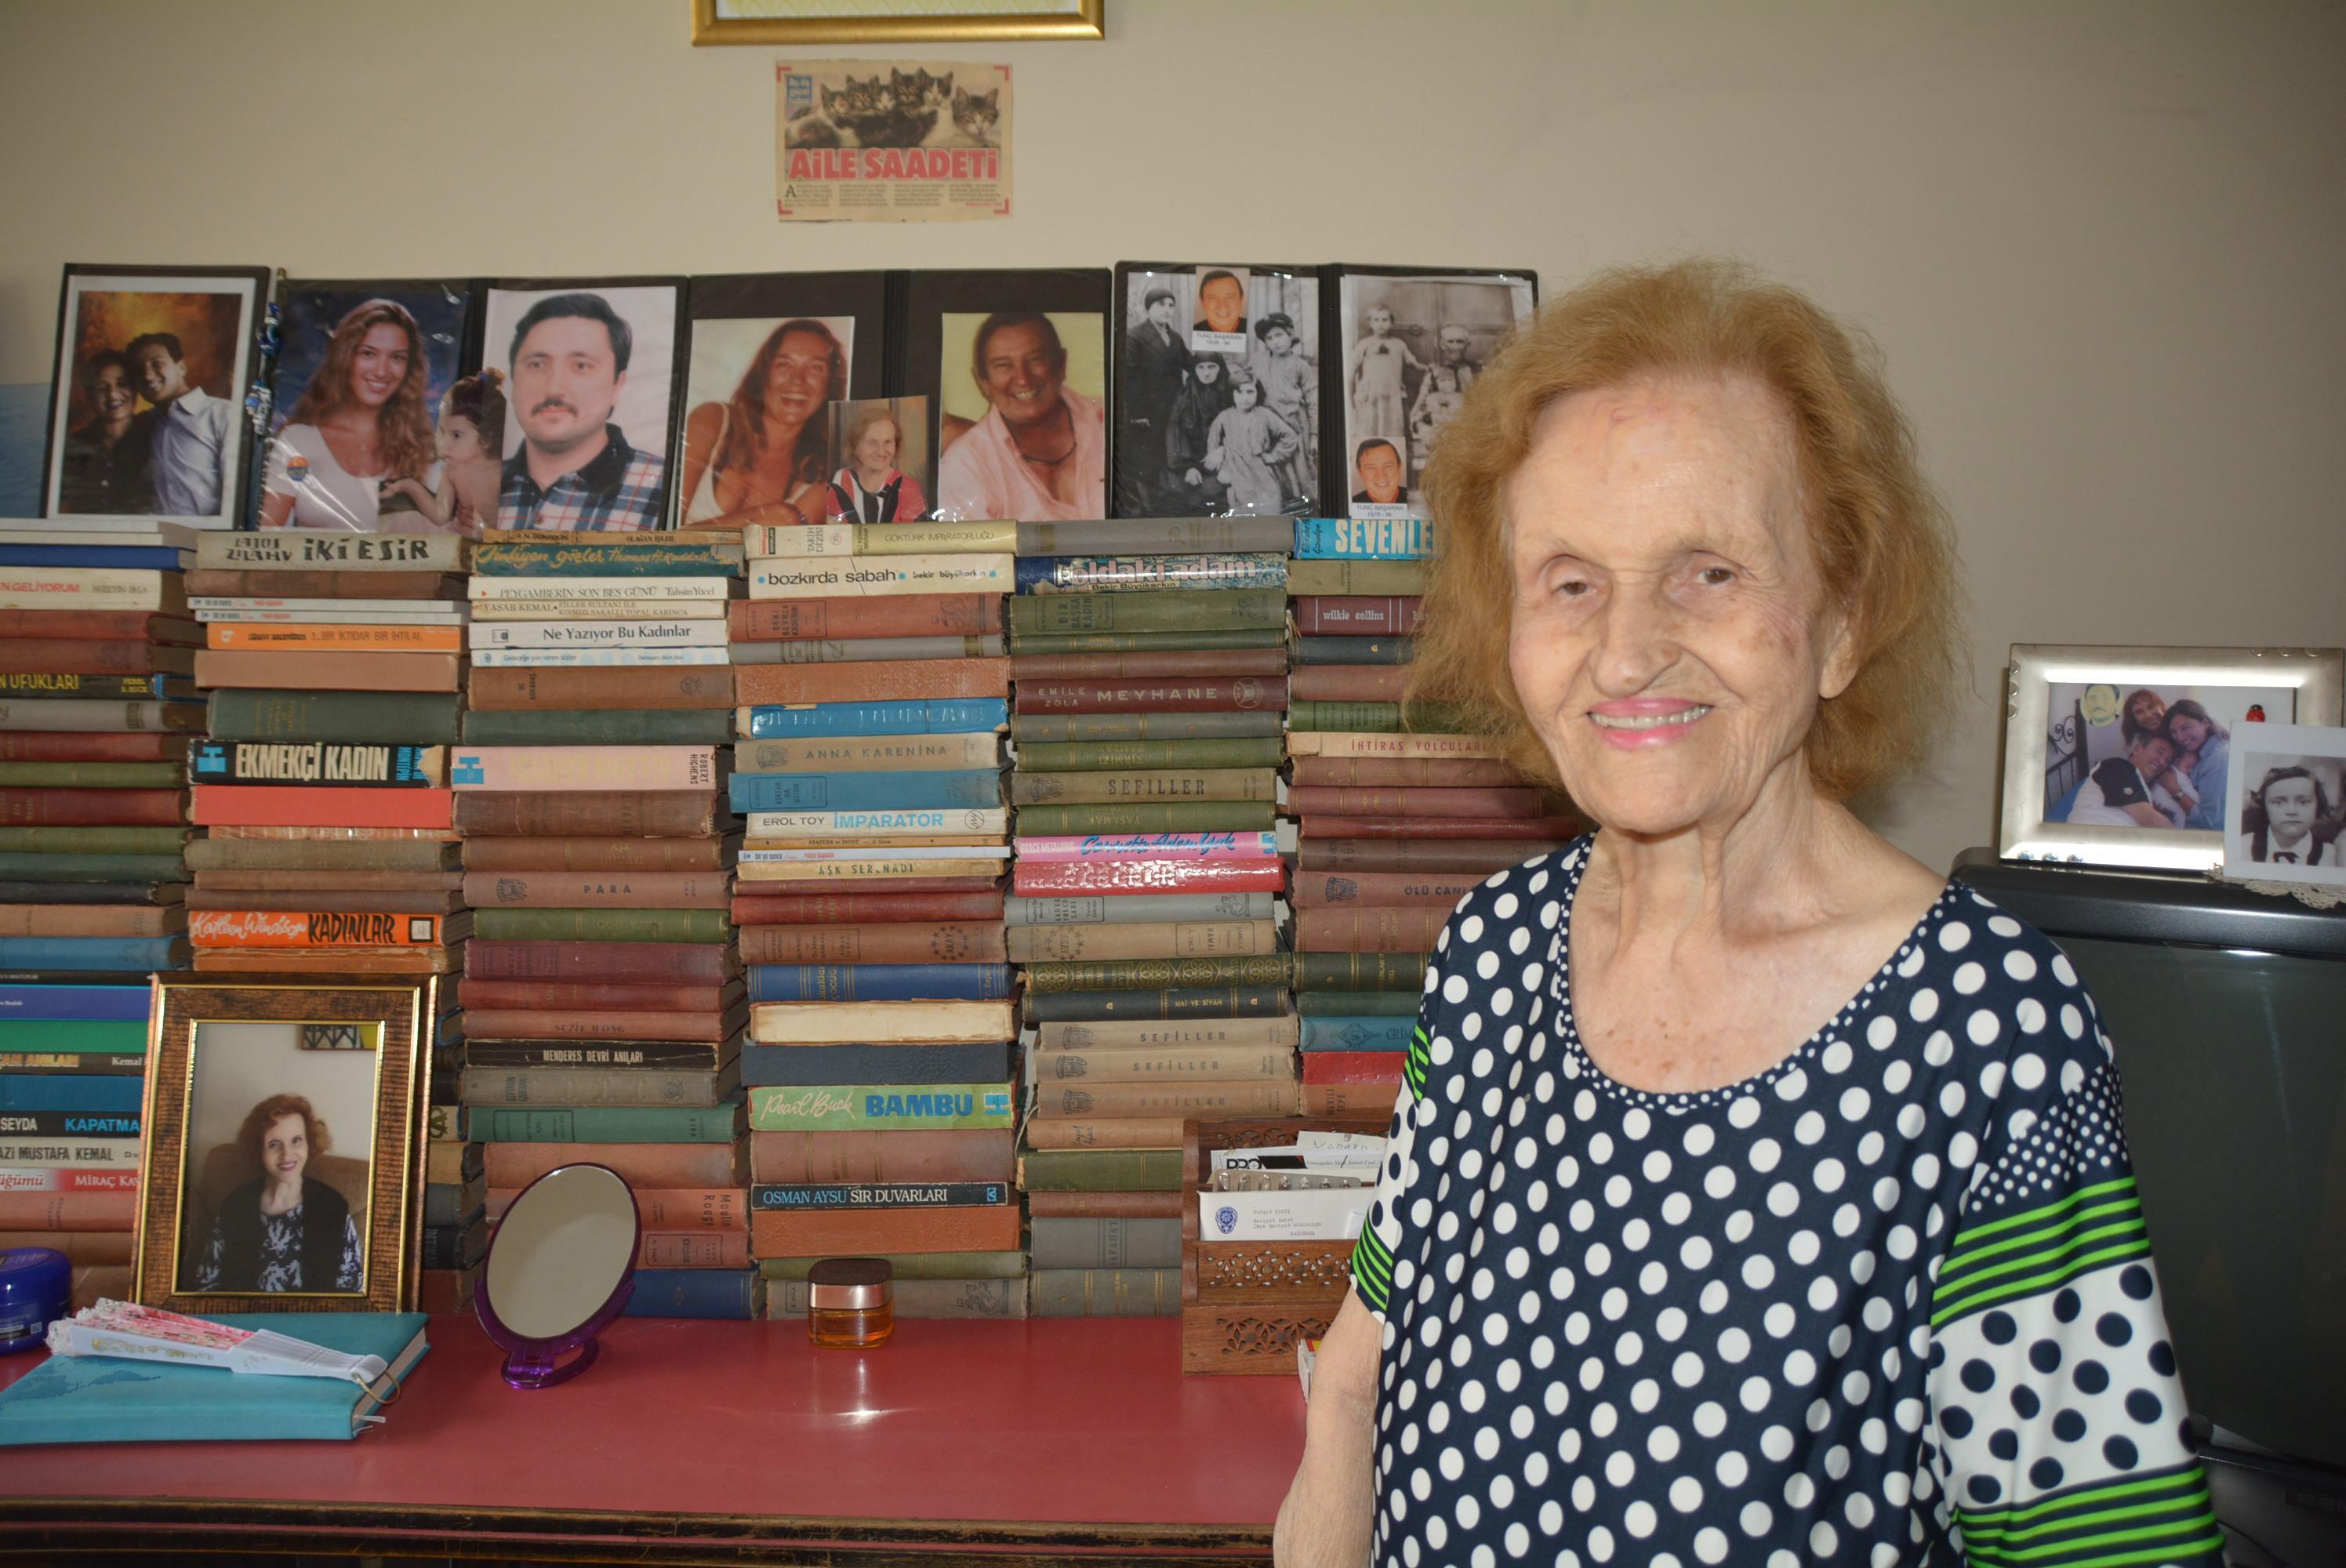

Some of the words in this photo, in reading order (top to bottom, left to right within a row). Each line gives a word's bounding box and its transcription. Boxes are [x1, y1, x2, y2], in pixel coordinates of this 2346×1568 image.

[1171, 557, 1256, 581] adam
[768, 571, 838, 586] bozkırda
[845, 569, 896, 583] sabah
[483, 603, 517, 612] YAŞAR
[519, 603, 554, 612] KEMAL
[1323, 611, 1350, 621] wilkie
[1355, 610, 1385, 621] collins
[543, 629, 561, 640] Ne
[565, 627, 616, 643] Yazıyor
[617, 626, 635, 639] Bu
[638, 624, 692, 638] Kadınlar
[10, 674, 79, 690] UFUKLARI
[1038, 687, 1085, 696] EMİLE
[1098, 688, 1218, 701] MEYHANE
[806, 748, 852, 760] ANNA
[862, 744, 948, 757] KARENİNA
[1352, 738, 1404, 752] İHTİRAS
[235, 741, 322, 782] EKMEKÇİ
[325, 746, 390, 782] KADIN
[699, 753, 709, 784] ROBERT
[1108, 779, 1205, 796] SEFİLLER
[763, 818, 796, 826] EROL
[800, 816, 825, 826] TOY
[833, 811, 944, 829] İMPARATOR
[819, 865, 841, 877] AŞK
[583, 884, 632, 895] PARA
[307, 913, 396, 943] KADINLAR
[1139, 1030, 1226, 1043] SEFİLLER
[543, 1049, 583, 1063] MENDERES
[586, 1047, 610, 1062] DEVRİ
[760, 1092, 812, 1122] Pearl
[809, 1091, 856, 1121] Buck
[865, 1093, 974, 1117] BAMBU
[0, 1118, 38, 1131] SEYDA
[65, 1118, 140, 1132] KAPATMA
[19, 1146, 70, 1160] MUSTAFA
[76, 1147, 114, 1161] KEMAL
[75, 1174, 116, 1189] MİRAÇ
[763, 1190, 809, 1204] OSMAN
[813, 1190, 847, 1203] AYSU
[875, 1189, 947, 1203] DUVARLARI
[1108, 1220, 1118, 1267] SAFAHAT
